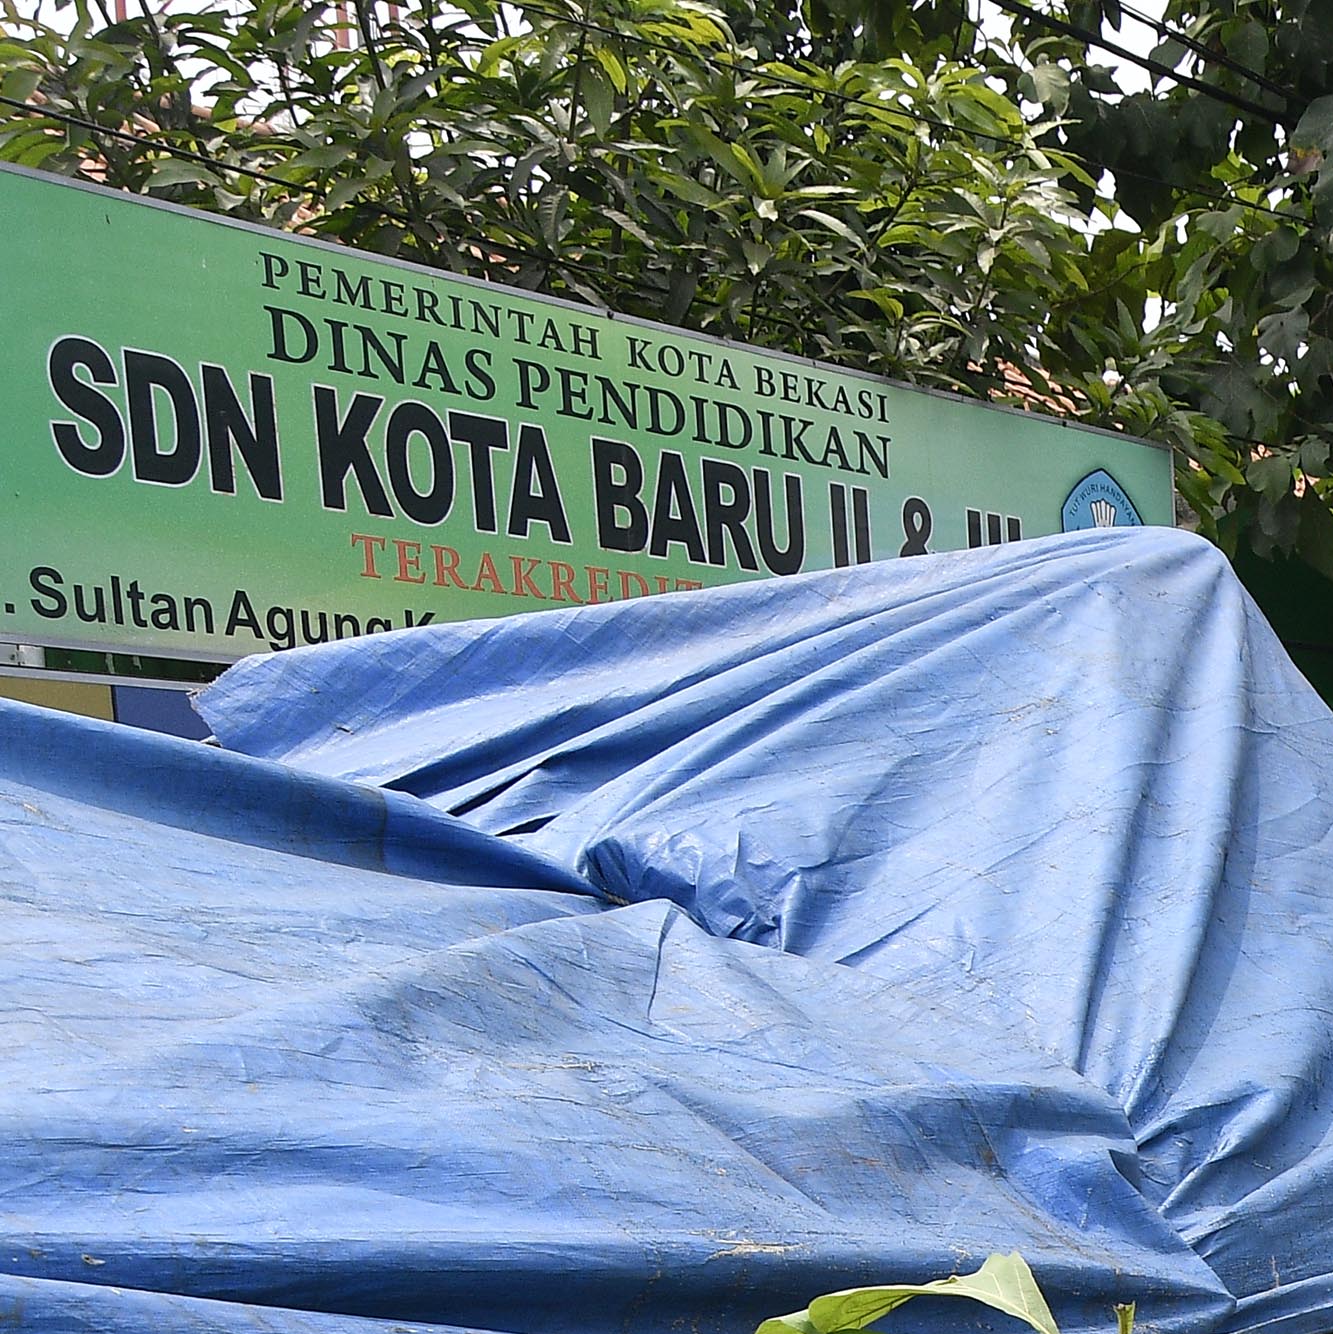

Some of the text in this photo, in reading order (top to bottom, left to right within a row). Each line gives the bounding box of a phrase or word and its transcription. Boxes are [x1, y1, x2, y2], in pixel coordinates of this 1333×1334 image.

[259, 251, 890, 424] PEMERINTAH KOTA BEKASI
[264, 304, 892, 480] DINAS PENDIDIKAN
[48, 334, 284, 503] SDN
[313, 384, 572, 545] KOTA
[591, 435, 807, 577] BARU
[899, 496, 934, 558] &
[1068, 496, 1081, 517] TUT
[1080, 484, 1099, 501] WURI
[29, 565, 215, 635] Sultan
